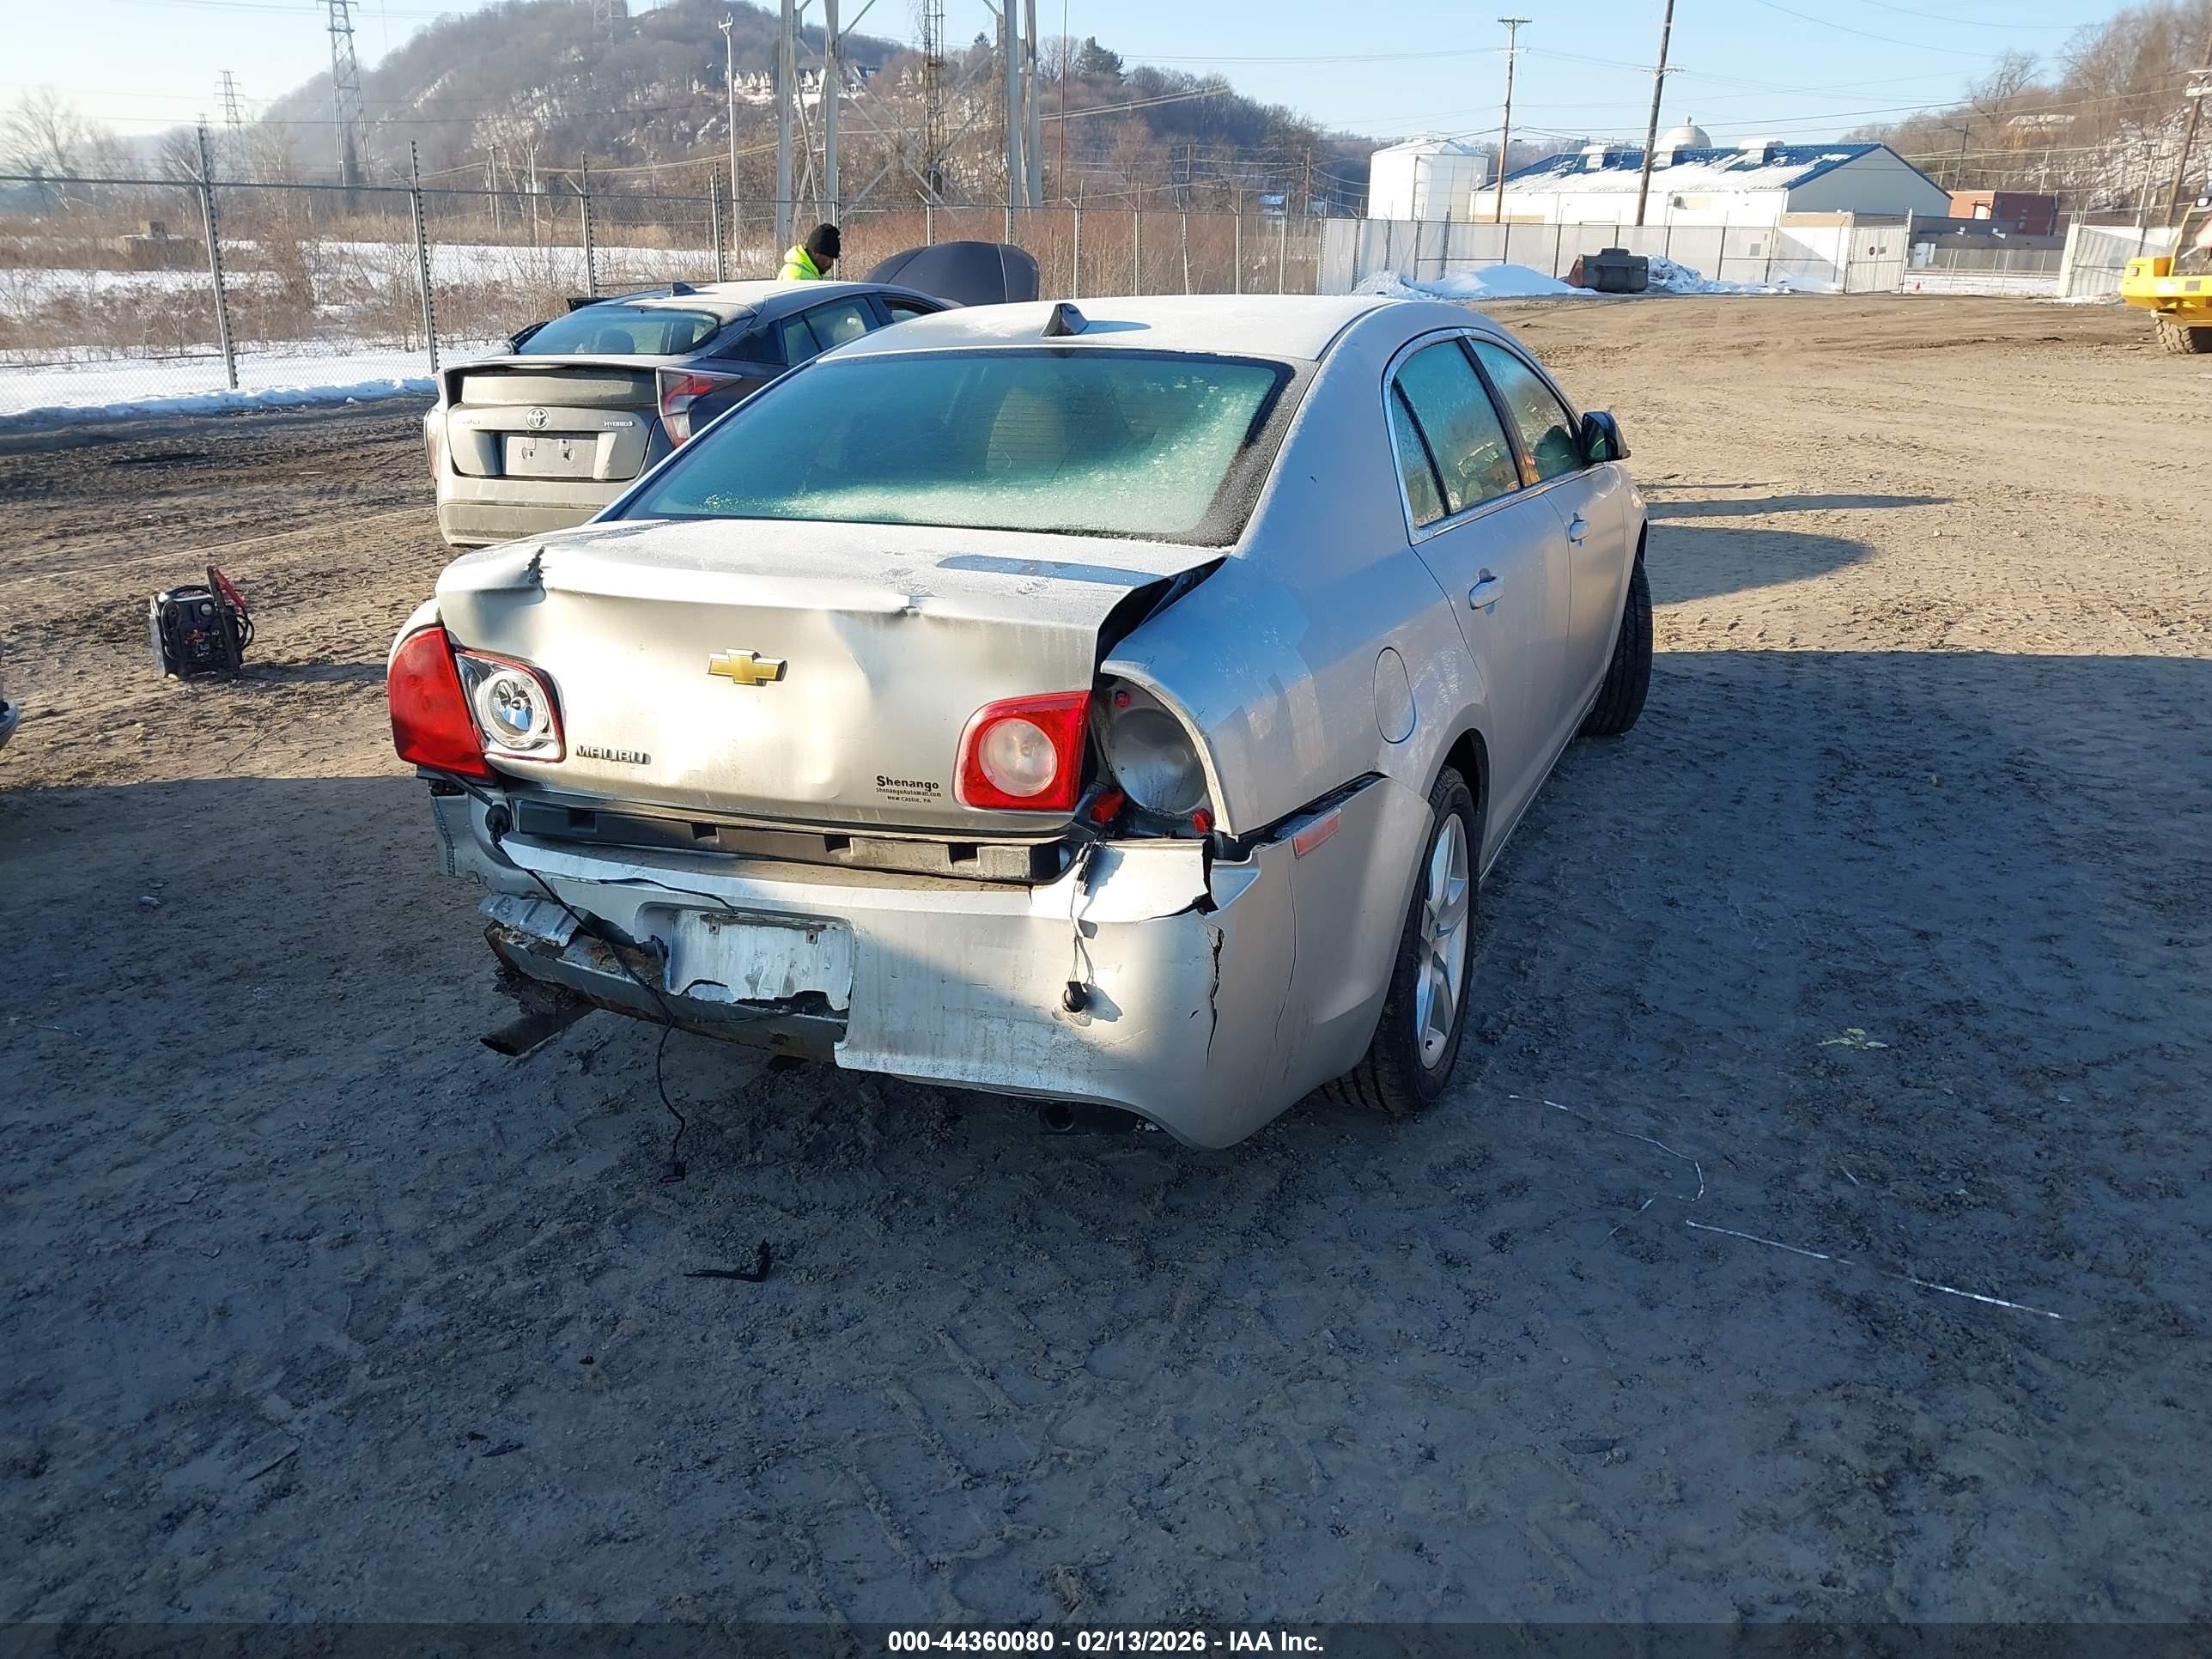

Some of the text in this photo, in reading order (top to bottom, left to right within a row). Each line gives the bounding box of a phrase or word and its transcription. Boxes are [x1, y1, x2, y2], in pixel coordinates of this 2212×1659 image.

[576, 744, 652, 765] MALIBU
[876, 775, 939, 792] Shenango
[876, 787, 942, 797] ShenangoAutoMall.com
